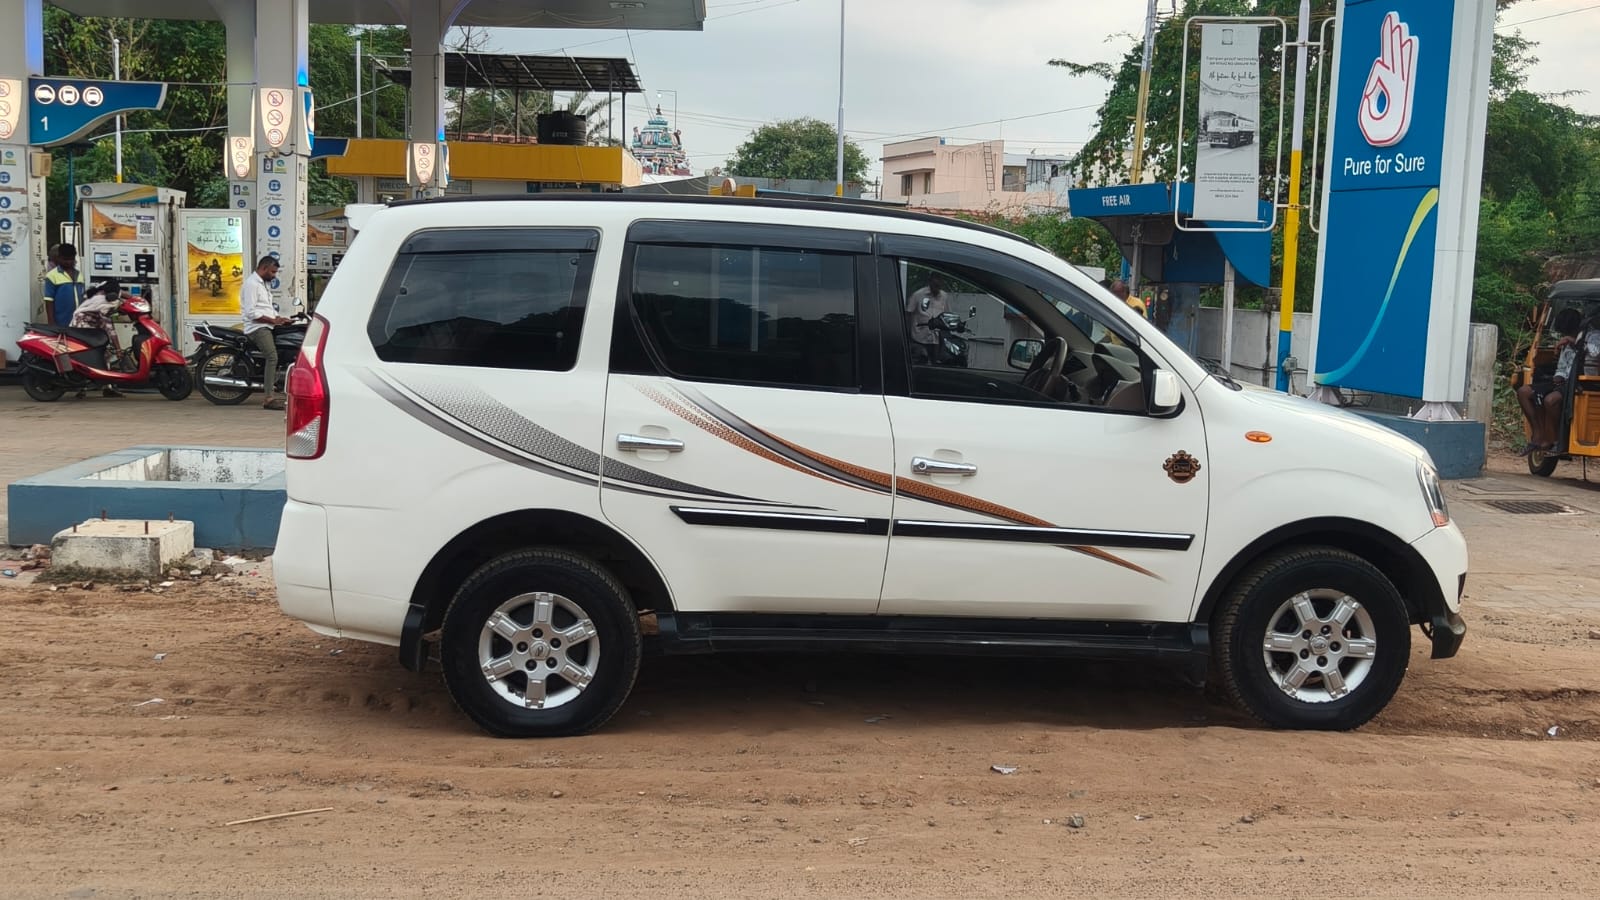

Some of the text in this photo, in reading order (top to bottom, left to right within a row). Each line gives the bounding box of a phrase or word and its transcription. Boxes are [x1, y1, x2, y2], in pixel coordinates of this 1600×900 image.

[40, 115, 48, 132] 1
[1343, 152, 1425, 176] Pure for Sure
[1102, 194, 1131, 207] FREE AIR
